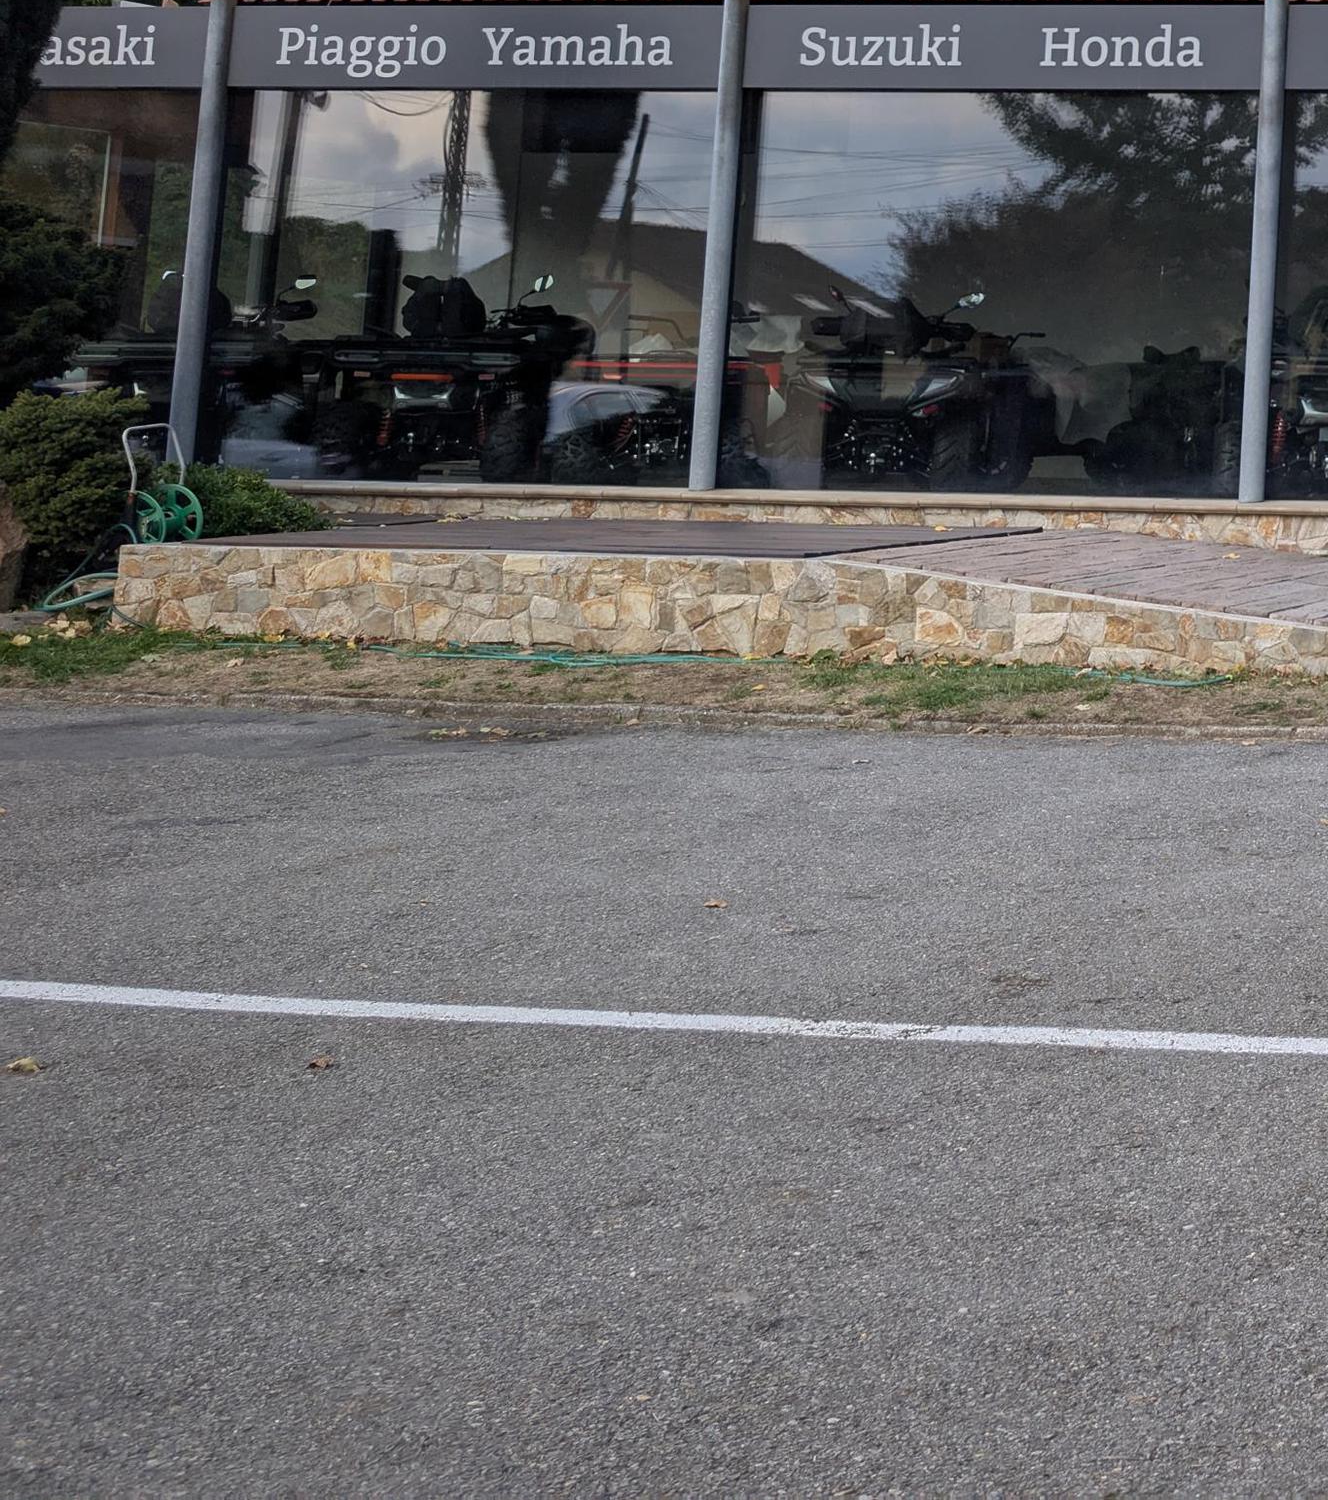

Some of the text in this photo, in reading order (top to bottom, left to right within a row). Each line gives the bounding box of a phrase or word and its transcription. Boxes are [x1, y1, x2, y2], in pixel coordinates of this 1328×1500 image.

[40, 24, 156, 66] asaki
[276, 23, 673, 78] Piaggio Yamaha
[799, 23, 1204, 67] Suzuki Honda
